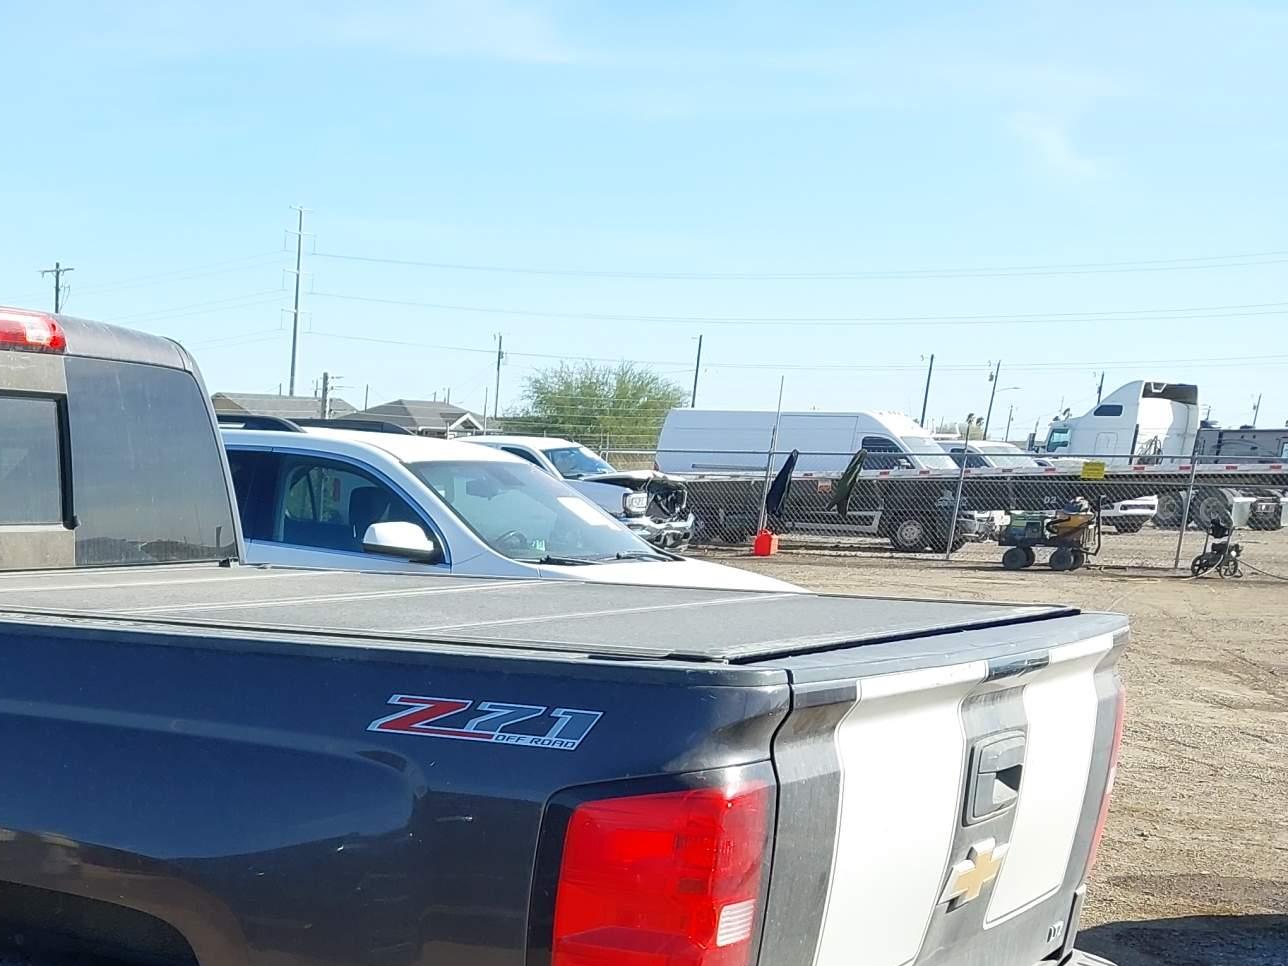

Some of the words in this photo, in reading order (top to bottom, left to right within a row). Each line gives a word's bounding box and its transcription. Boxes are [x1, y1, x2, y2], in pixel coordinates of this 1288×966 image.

[366, 694, 604, 745] Z71
[494, 734, 527, 744] OFF
[529, 737, 577, 749] ROAD
